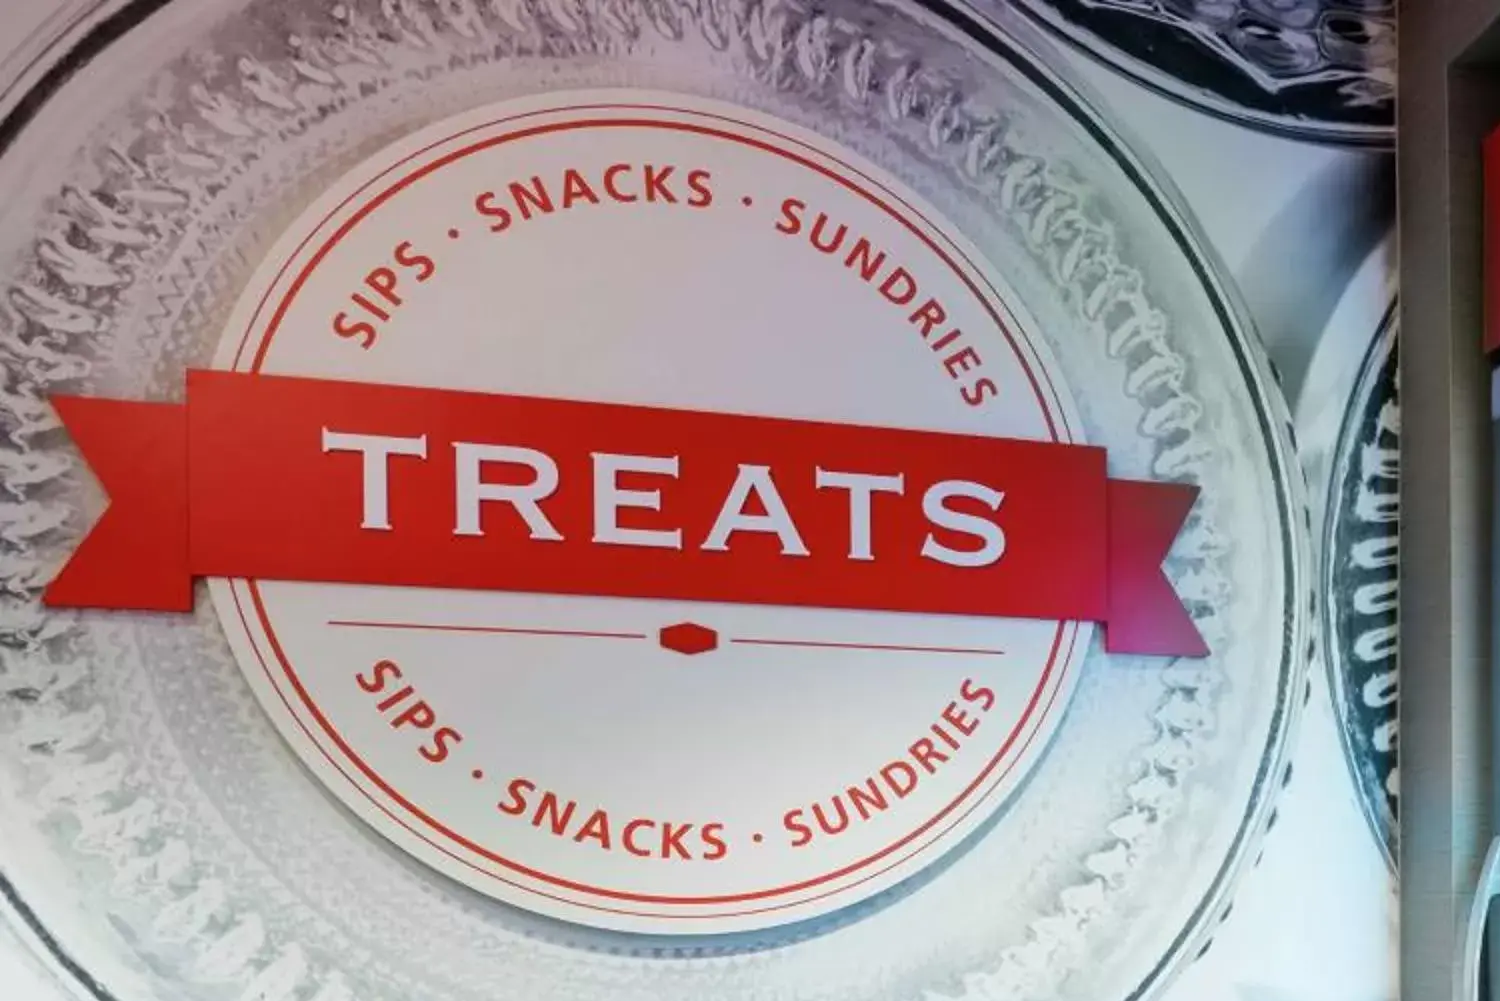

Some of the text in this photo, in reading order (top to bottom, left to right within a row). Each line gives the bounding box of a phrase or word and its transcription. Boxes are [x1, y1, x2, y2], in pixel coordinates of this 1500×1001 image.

[331, 161, 998, 409] SIPS SNACKS SUNDRIES
[321, 427, 1007, 568] TREATS
[355, 659, 997, 862] SIPS SNACKS SUNDRIES
